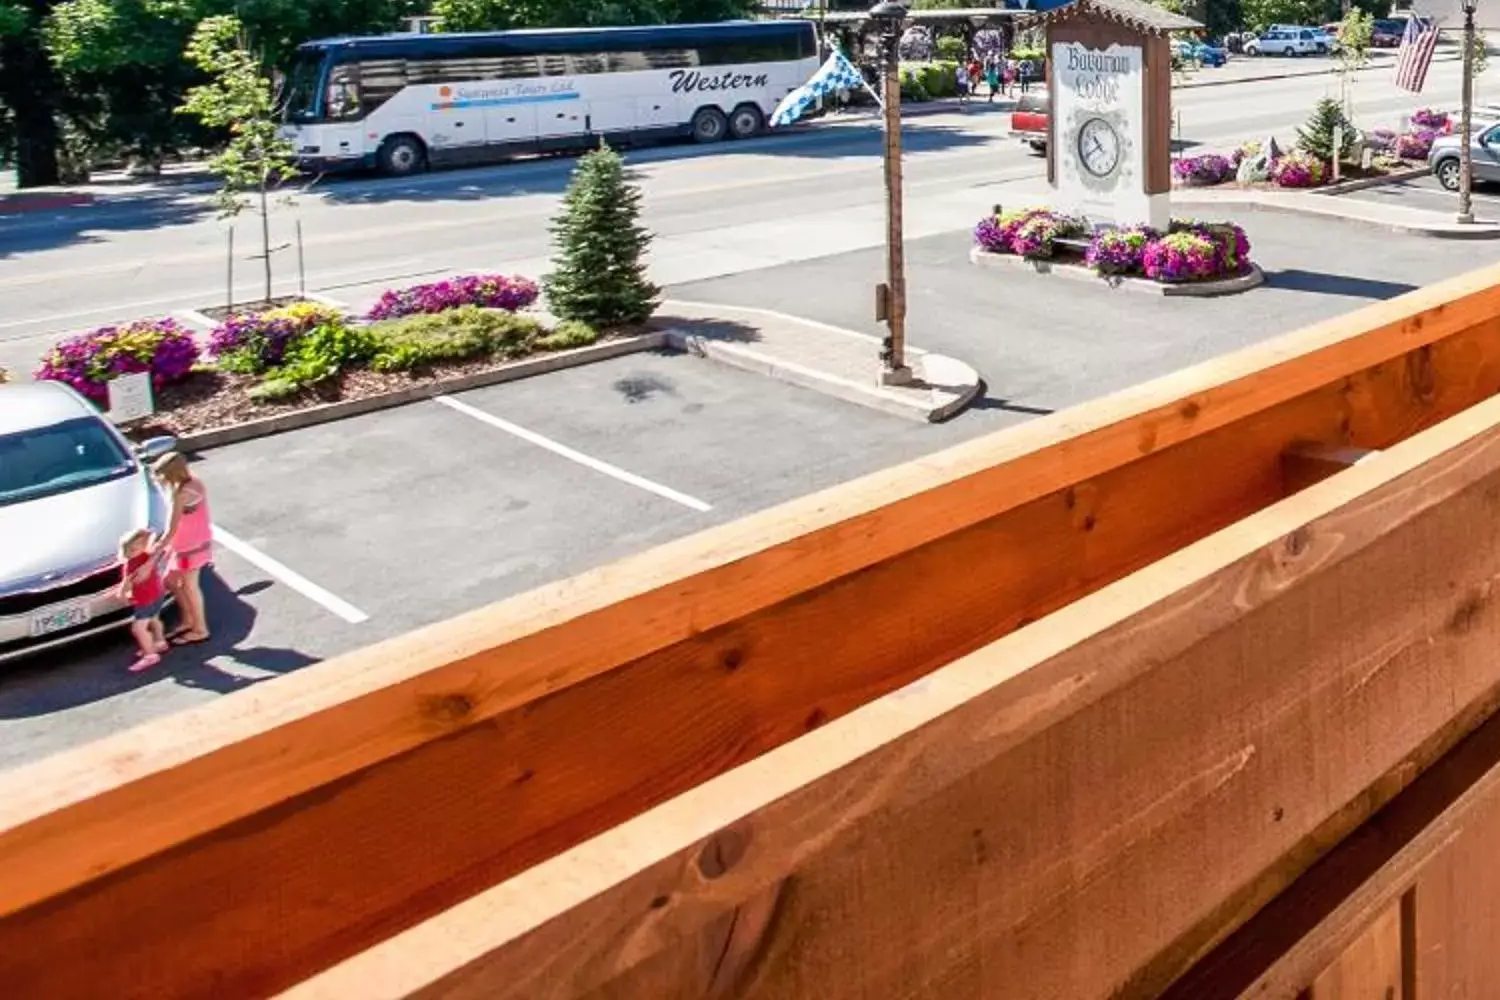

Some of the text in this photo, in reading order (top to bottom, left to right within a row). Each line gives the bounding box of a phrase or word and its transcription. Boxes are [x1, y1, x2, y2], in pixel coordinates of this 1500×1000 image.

[1066, 47, 1129, 74] Bavarian
[669, 70, 768, 93] Western
[1073, 74, 1120, 104] Lodge
